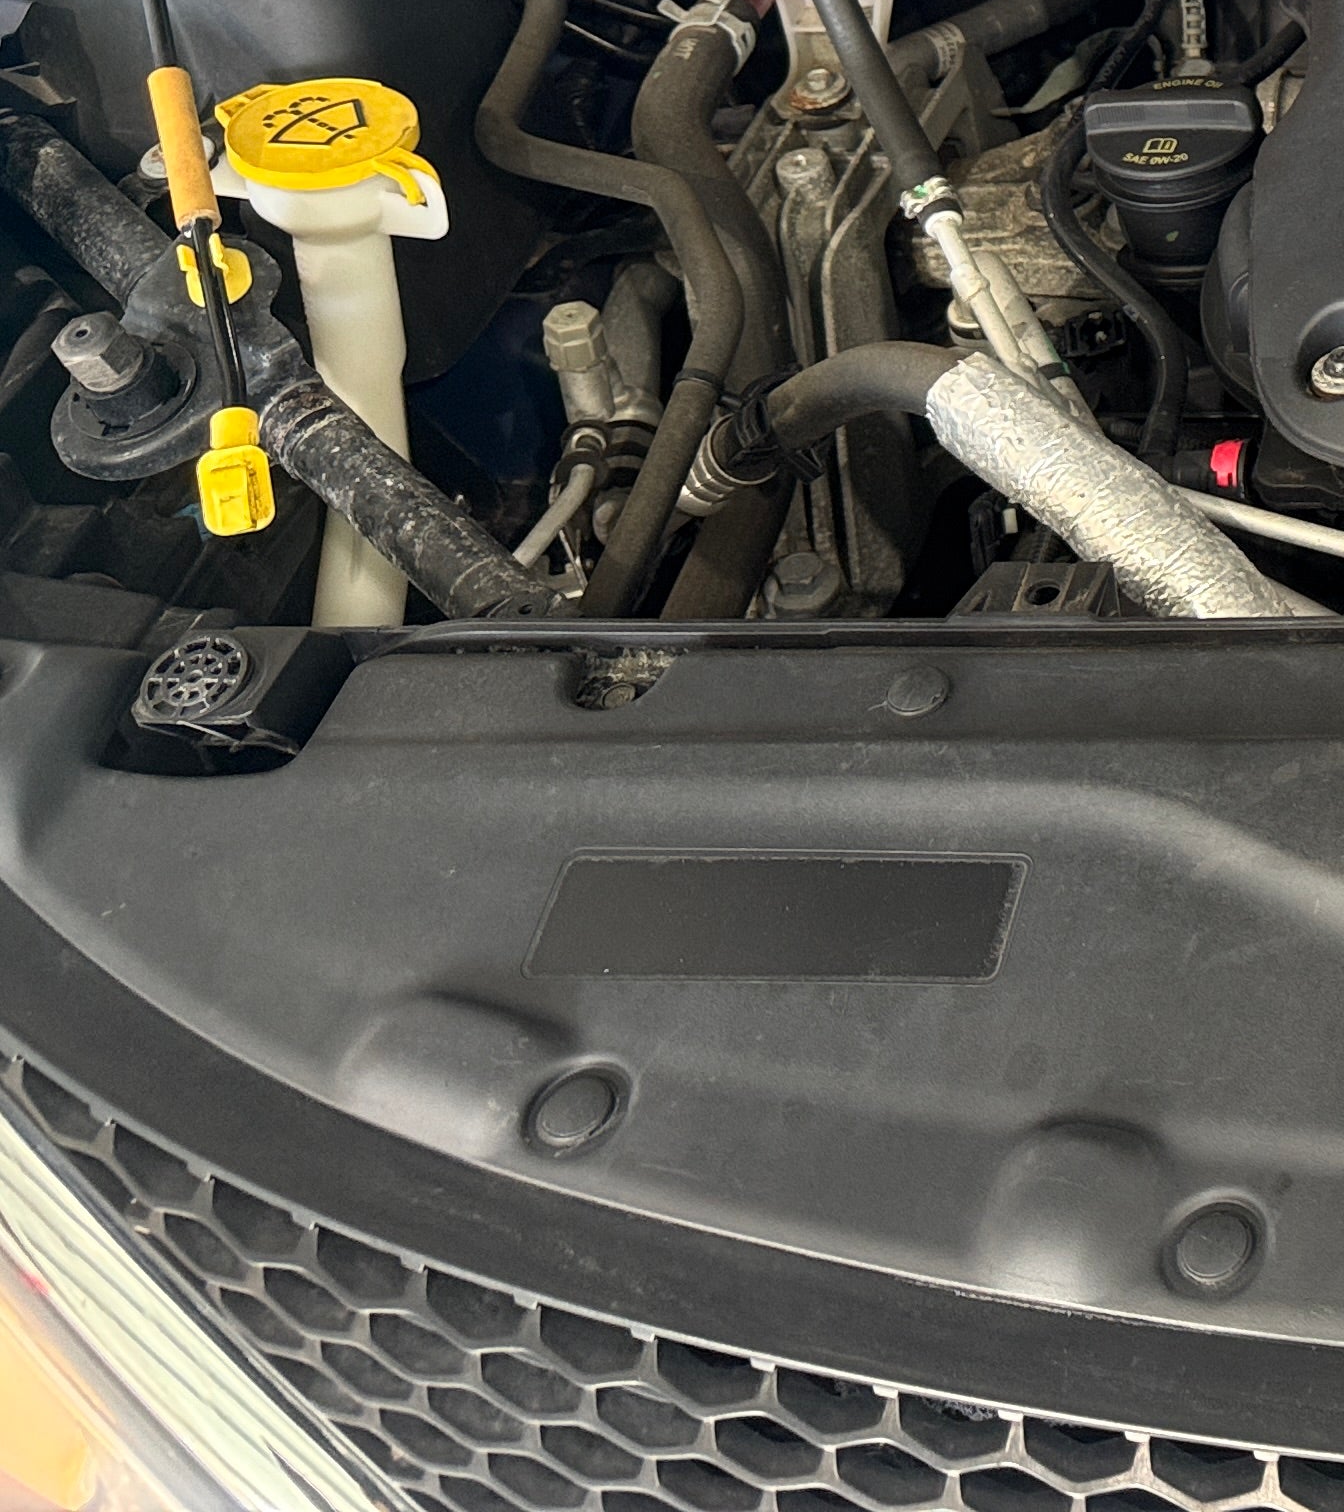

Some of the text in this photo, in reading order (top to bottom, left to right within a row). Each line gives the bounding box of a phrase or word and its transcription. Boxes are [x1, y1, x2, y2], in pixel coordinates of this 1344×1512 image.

[1153, 79, 1204, 90] ENGINE
[1122, 152, 1189, 165] SAE 0W-20
